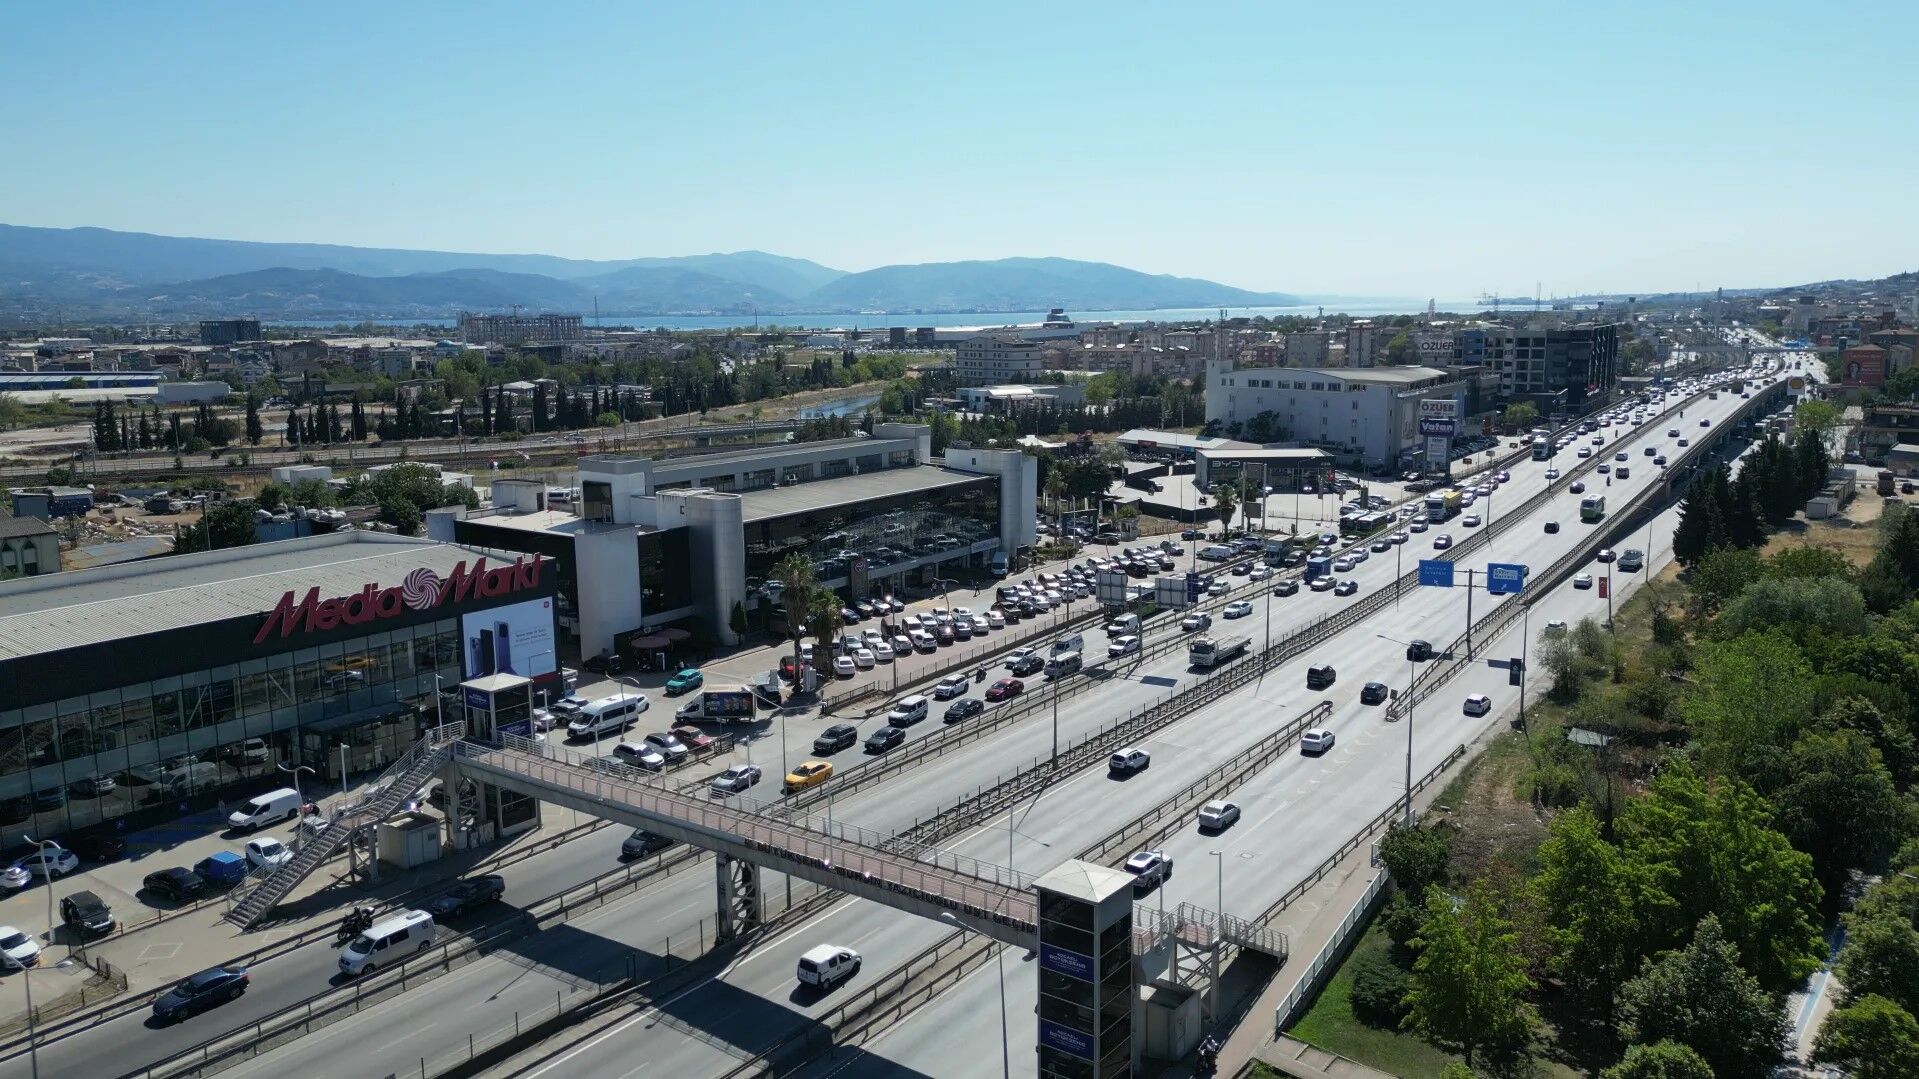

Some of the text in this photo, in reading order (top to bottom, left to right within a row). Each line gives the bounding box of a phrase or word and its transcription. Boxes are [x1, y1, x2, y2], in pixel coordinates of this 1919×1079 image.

[1421, 421, 1454, 432] Vatan
[1211, 460, 1241, 468] BYD
[253, 552, 541, 644] Media Markt
